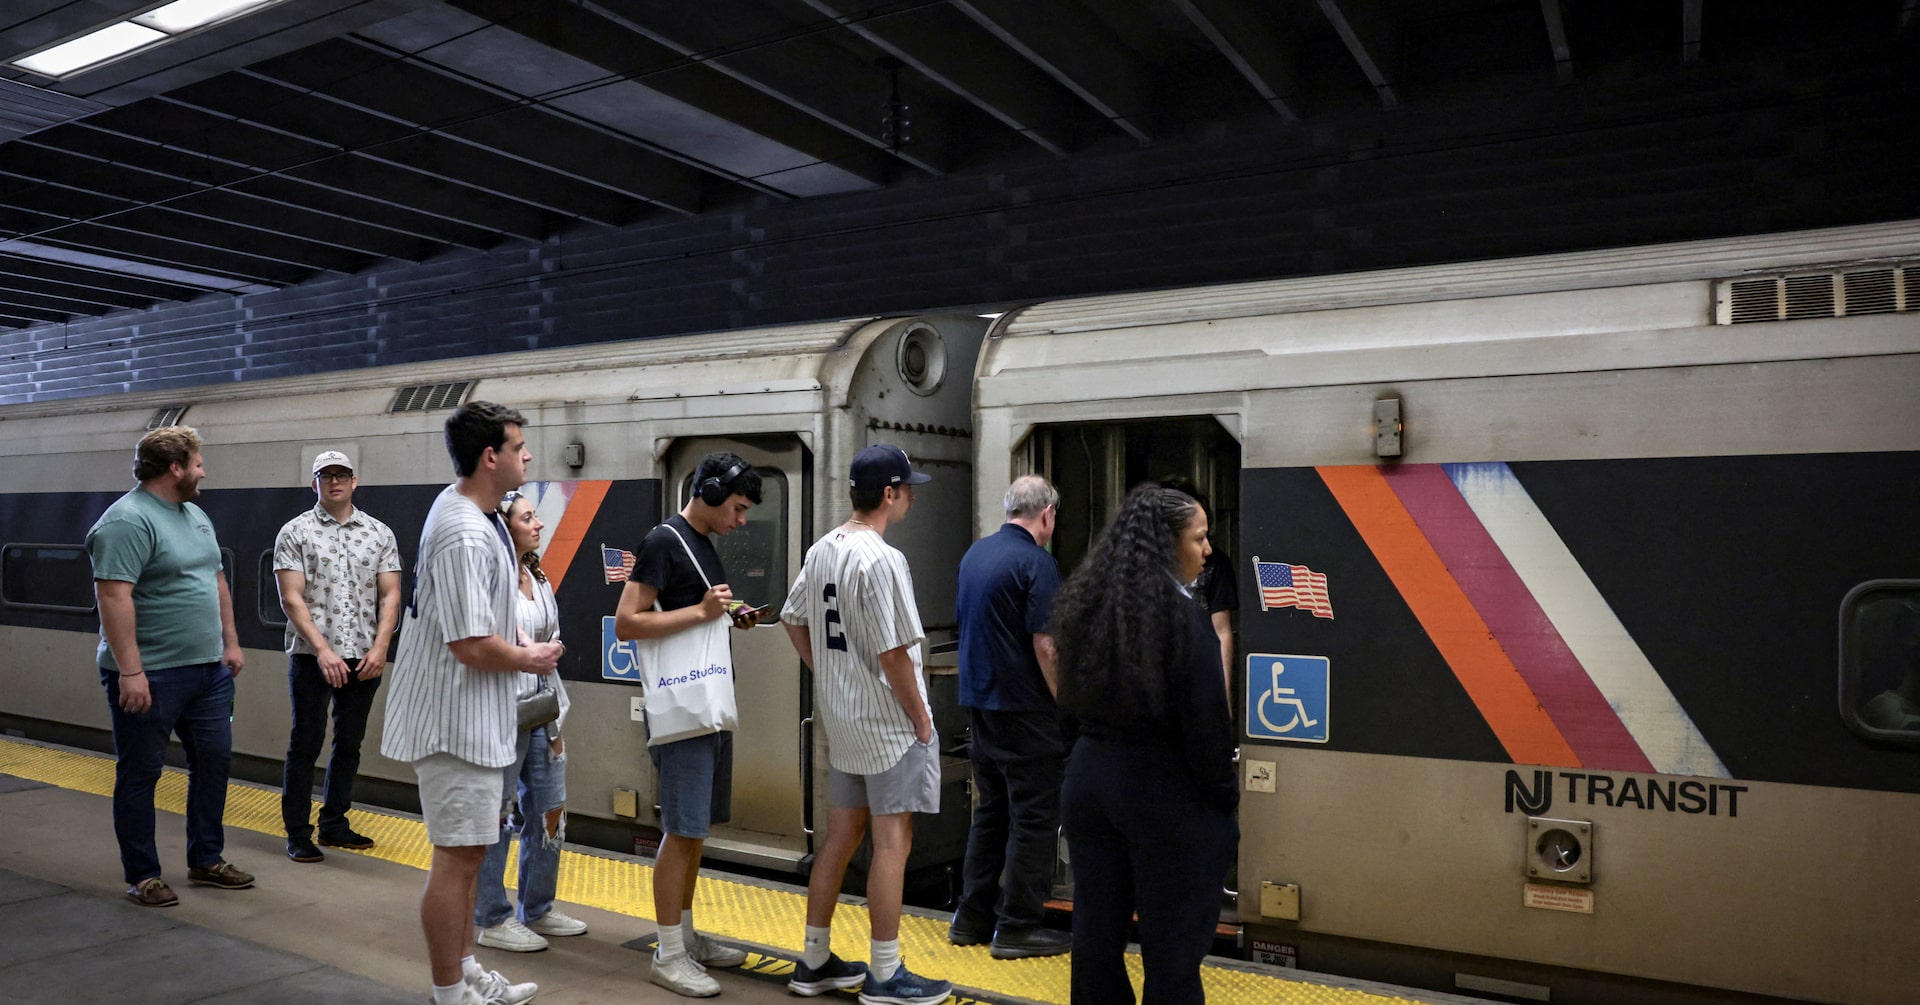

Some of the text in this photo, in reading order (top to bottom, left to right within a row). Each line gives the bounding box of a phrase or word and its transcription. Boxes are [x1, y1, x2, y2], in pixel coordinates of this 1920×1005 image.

[823, 583, 848, 652] 2
[658, 664, 727, 689] Acne Studios
[1505, 769, 1749, 817] NJ TRANSIT
[1253, 941, 1295, 955] DANGER
